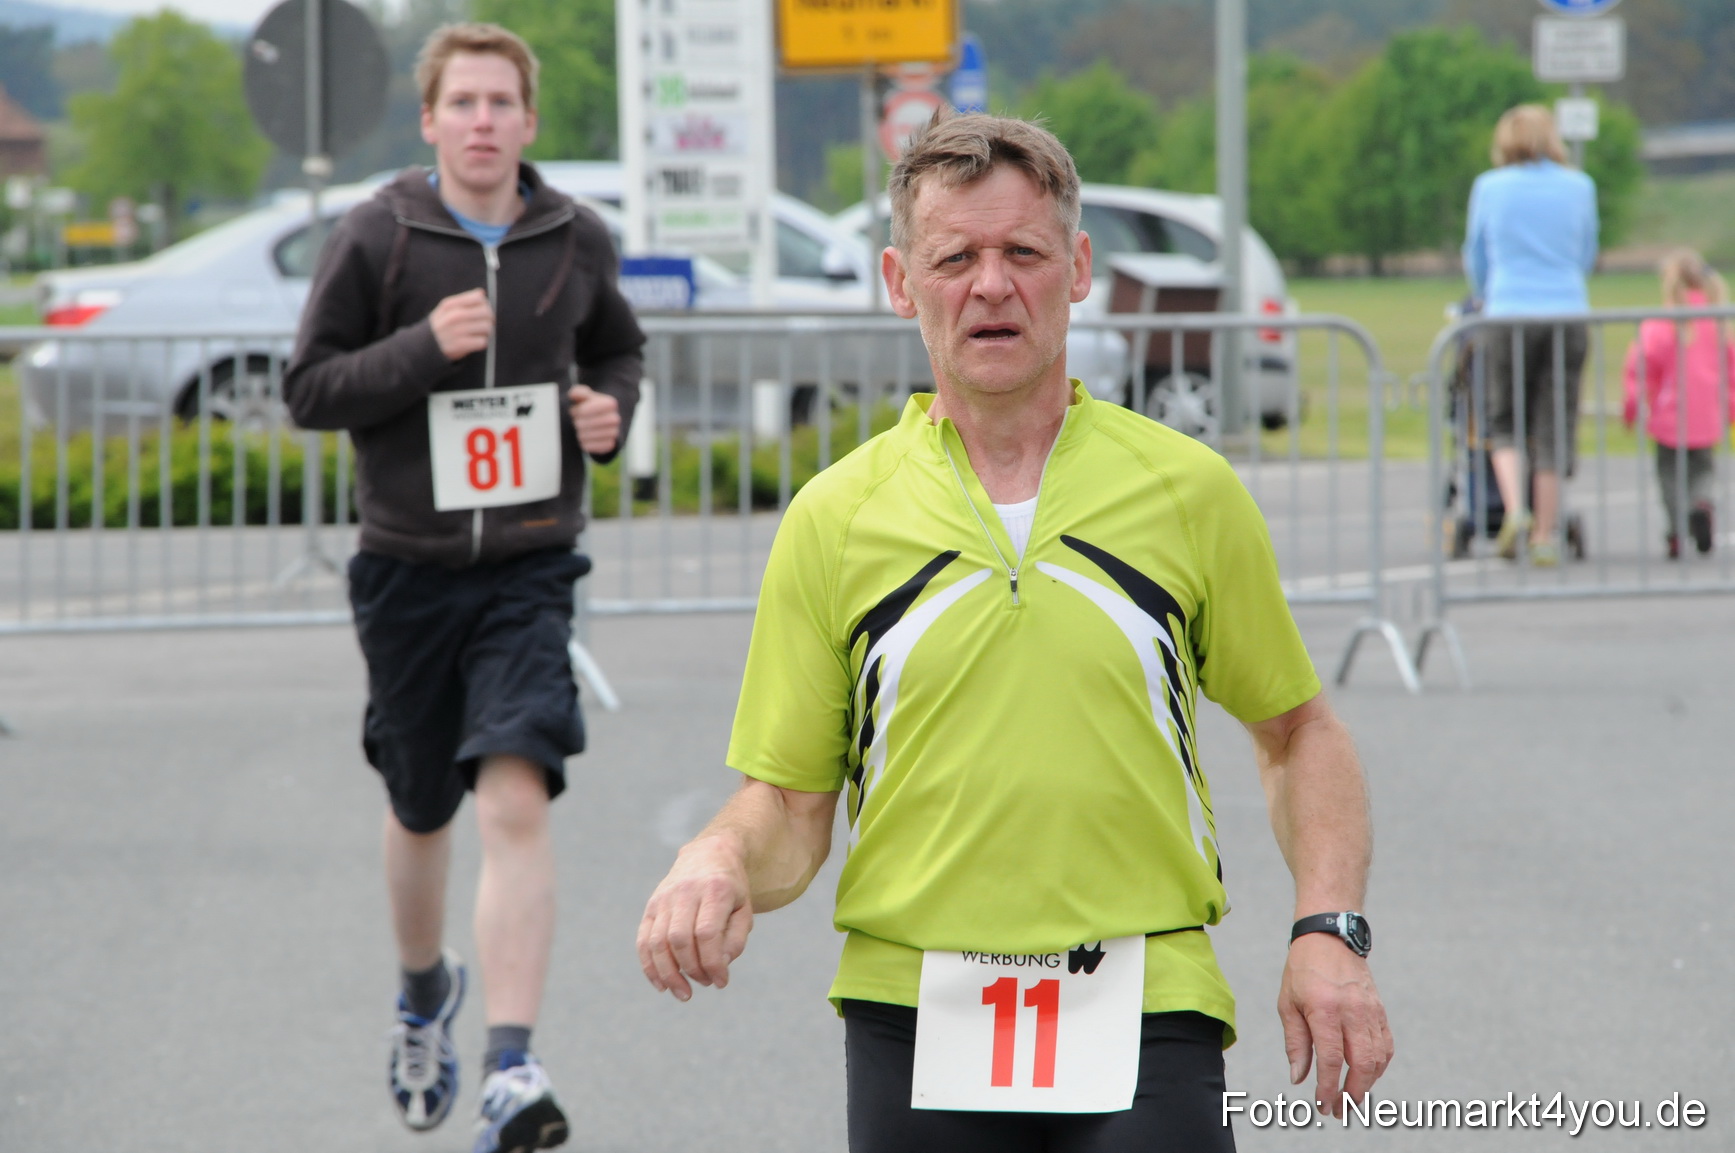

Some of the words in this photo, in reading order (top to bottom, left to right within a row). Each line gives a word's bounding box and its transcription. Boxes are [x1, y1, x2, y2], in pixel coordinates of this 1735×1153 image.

[466, 426, 523, 491] 81
[962, 950, 1061, 969] WERBUNG
[981, 976, 1061, 1088] 11
